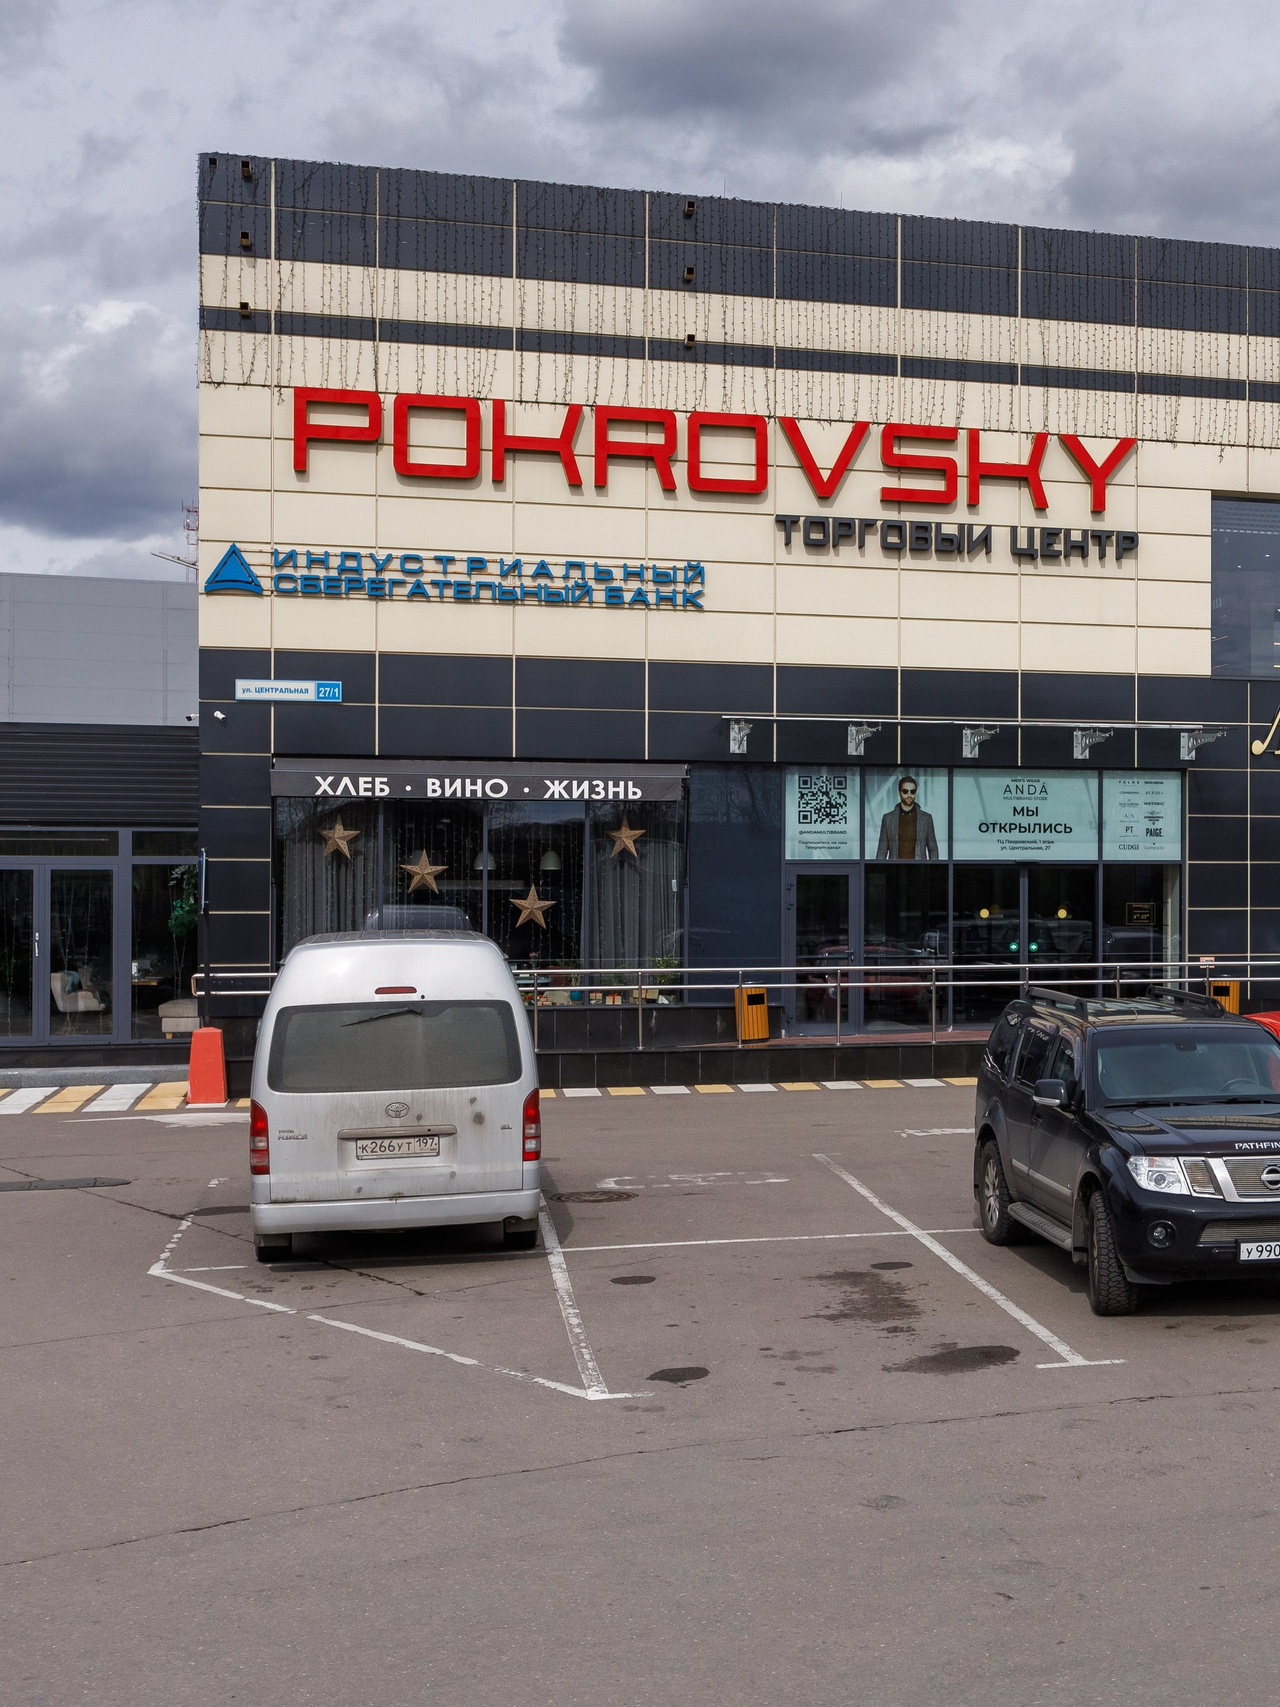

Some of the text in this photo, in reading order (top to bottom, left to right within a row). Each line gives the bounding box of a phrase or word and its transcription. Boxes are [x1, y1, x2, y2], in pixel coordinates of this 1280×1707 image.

[293, 386, 1138, 513] POKROVSKY
[1010, 525, 1139, 560] ЦЕНТР
[272, 548, 705, 585] ИНДУСТРИАЛЬНЫЙ
[272, 573, 706, 608] СБЕРЕГАТЕЛЬНЫЙ БАНК
[241, 686, 339, 698] ул. ЦЕНТРАЛЬНАЯ 27/1
[314, 776, 642, 800] ХЛЕБ ВИНО ЖИЗНЬ
[1003, 782, 1048, 795] ANDÁ
[1013, 806, 1039, 817] МЫ
[978, 822, 1073, 834] ОТКРЫЛИСЬ
[361, 1137, 435, 1154] К266УТ 197
